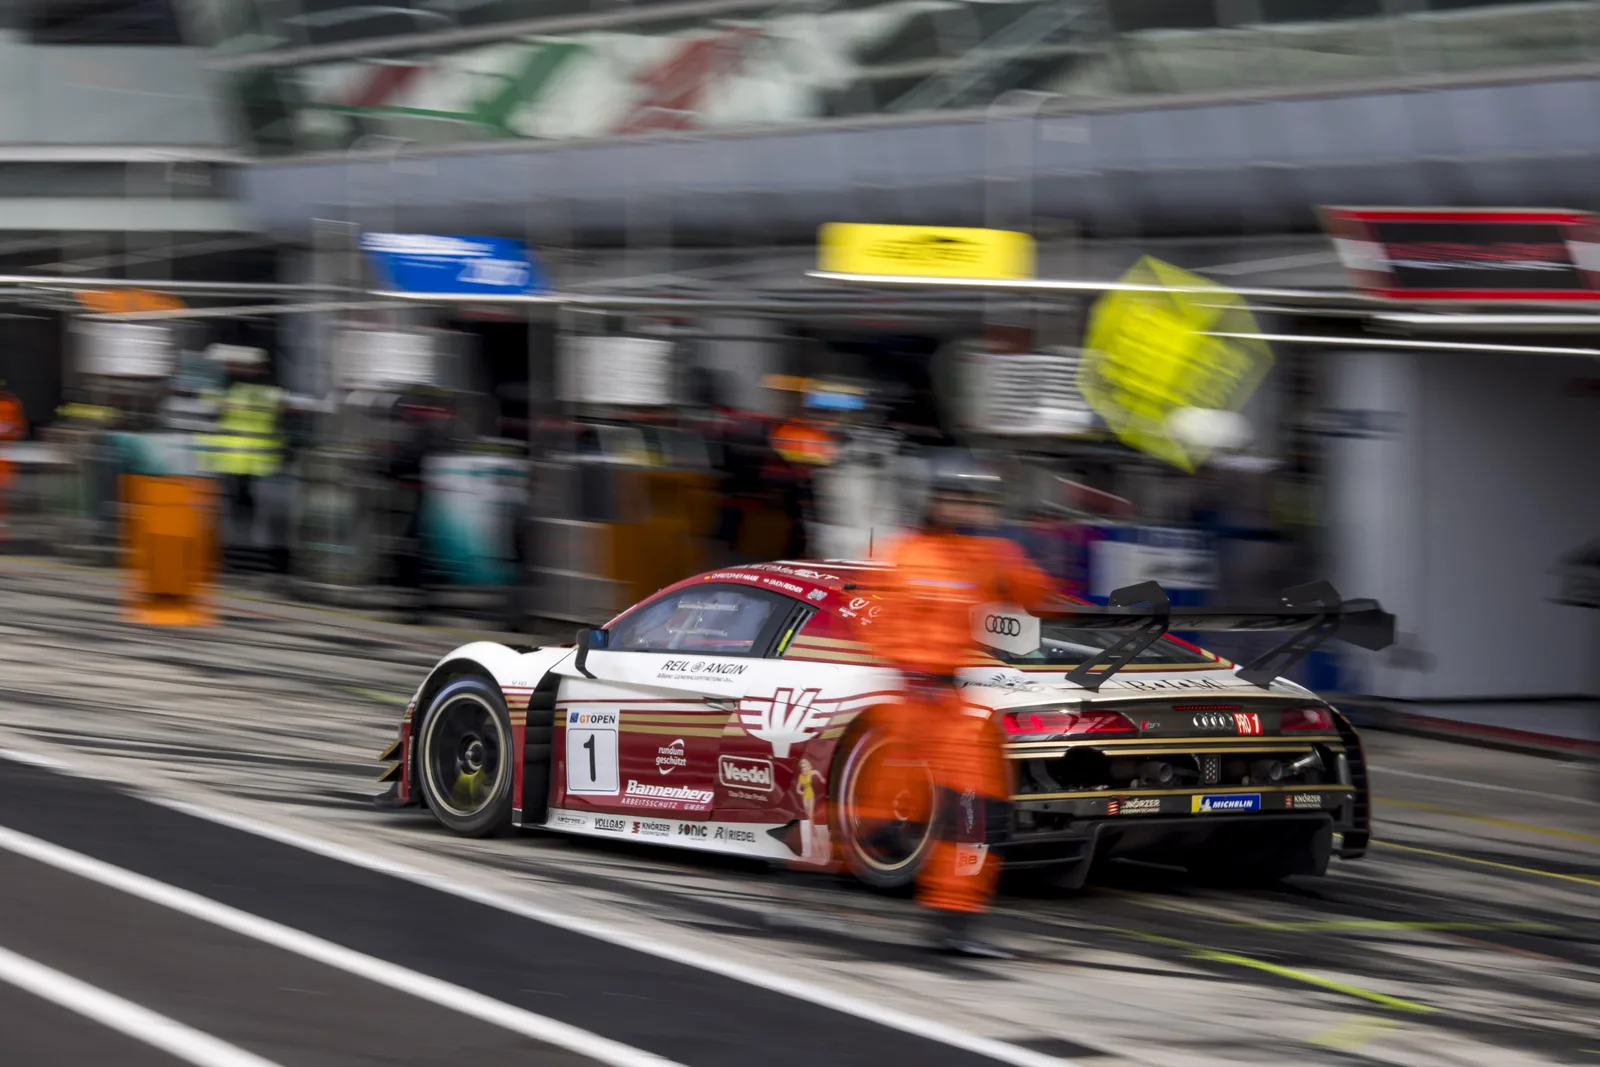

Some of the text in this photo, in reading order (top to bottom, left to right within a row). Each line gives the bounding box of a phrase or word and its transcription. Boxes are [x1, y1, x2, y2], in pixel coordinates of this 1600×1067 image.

[661, 660, 749, 675] REIL ANGIN
[1234, 713, 1260, 734] PRO 1
[658, 746, 684, 756] rundum
[583, 734, 596, 782] 1
[655, 755, 687, 767] geschützt
[722, 762, 770, 784] Veedol
[625, 779, 715, 804] Bannenberg
[1293, 793, 1322, 803] KNÖRZER
[621, 798, 706, 811] ARBEITSSCHUTZ GMBH
[1212, 799, 1253, 809] MICHELIN
[594, 817, 625, 829] VOLLGAS!
[642, 821, 671, 832] KNÖRZER
[728, 830, 756, 843] RIEDEL
